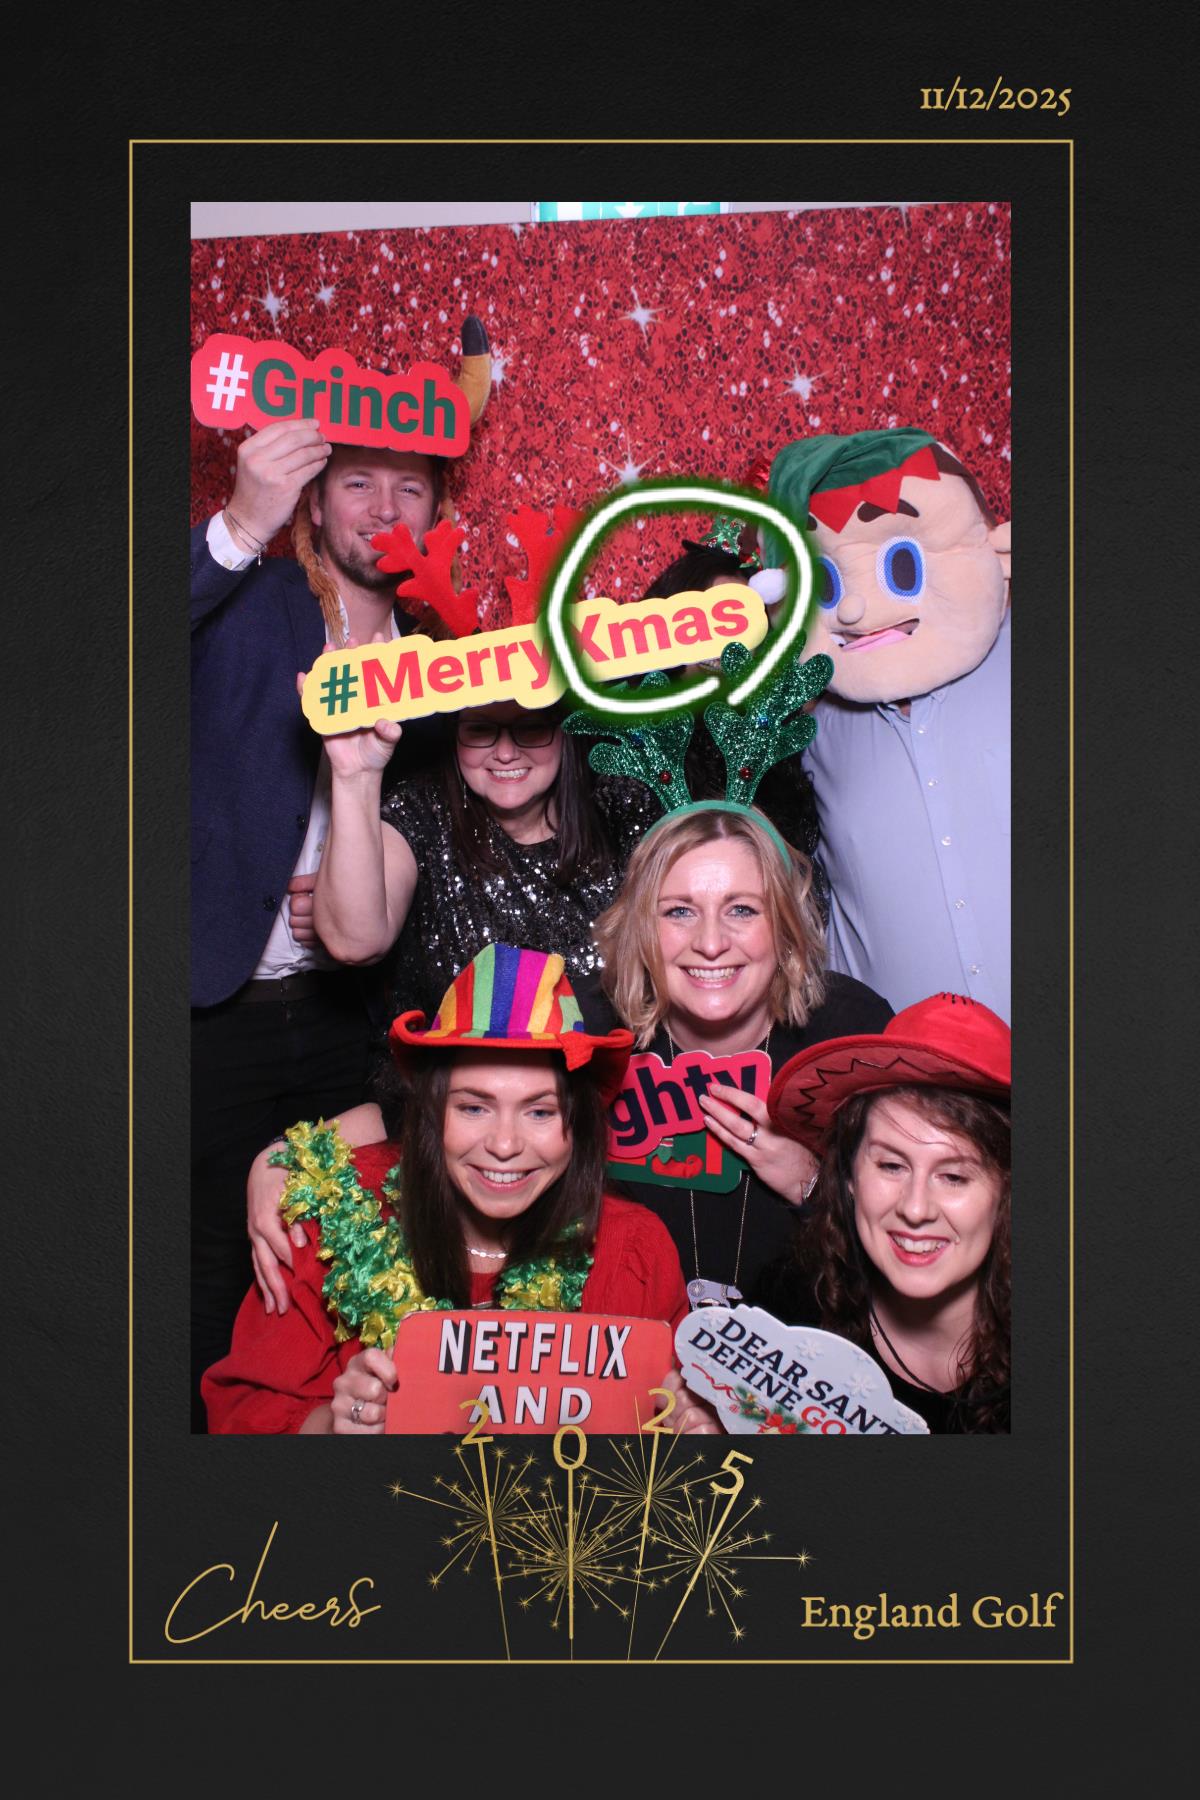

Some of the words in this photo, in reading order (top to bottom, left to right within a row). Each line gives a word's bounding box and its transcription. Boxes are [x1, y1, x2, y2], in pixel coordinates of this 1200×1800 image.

[206, 352, 456, 440] #Grinch
[610, 1064, 757, 1147] ghty
[438, 1319, 631, 1378] NETFLIX
[688, 1327, 803, 1412] DEFINE
[716, 1317, 808, 1388] DEAR
[469, 1385, 593, 1426] AND
